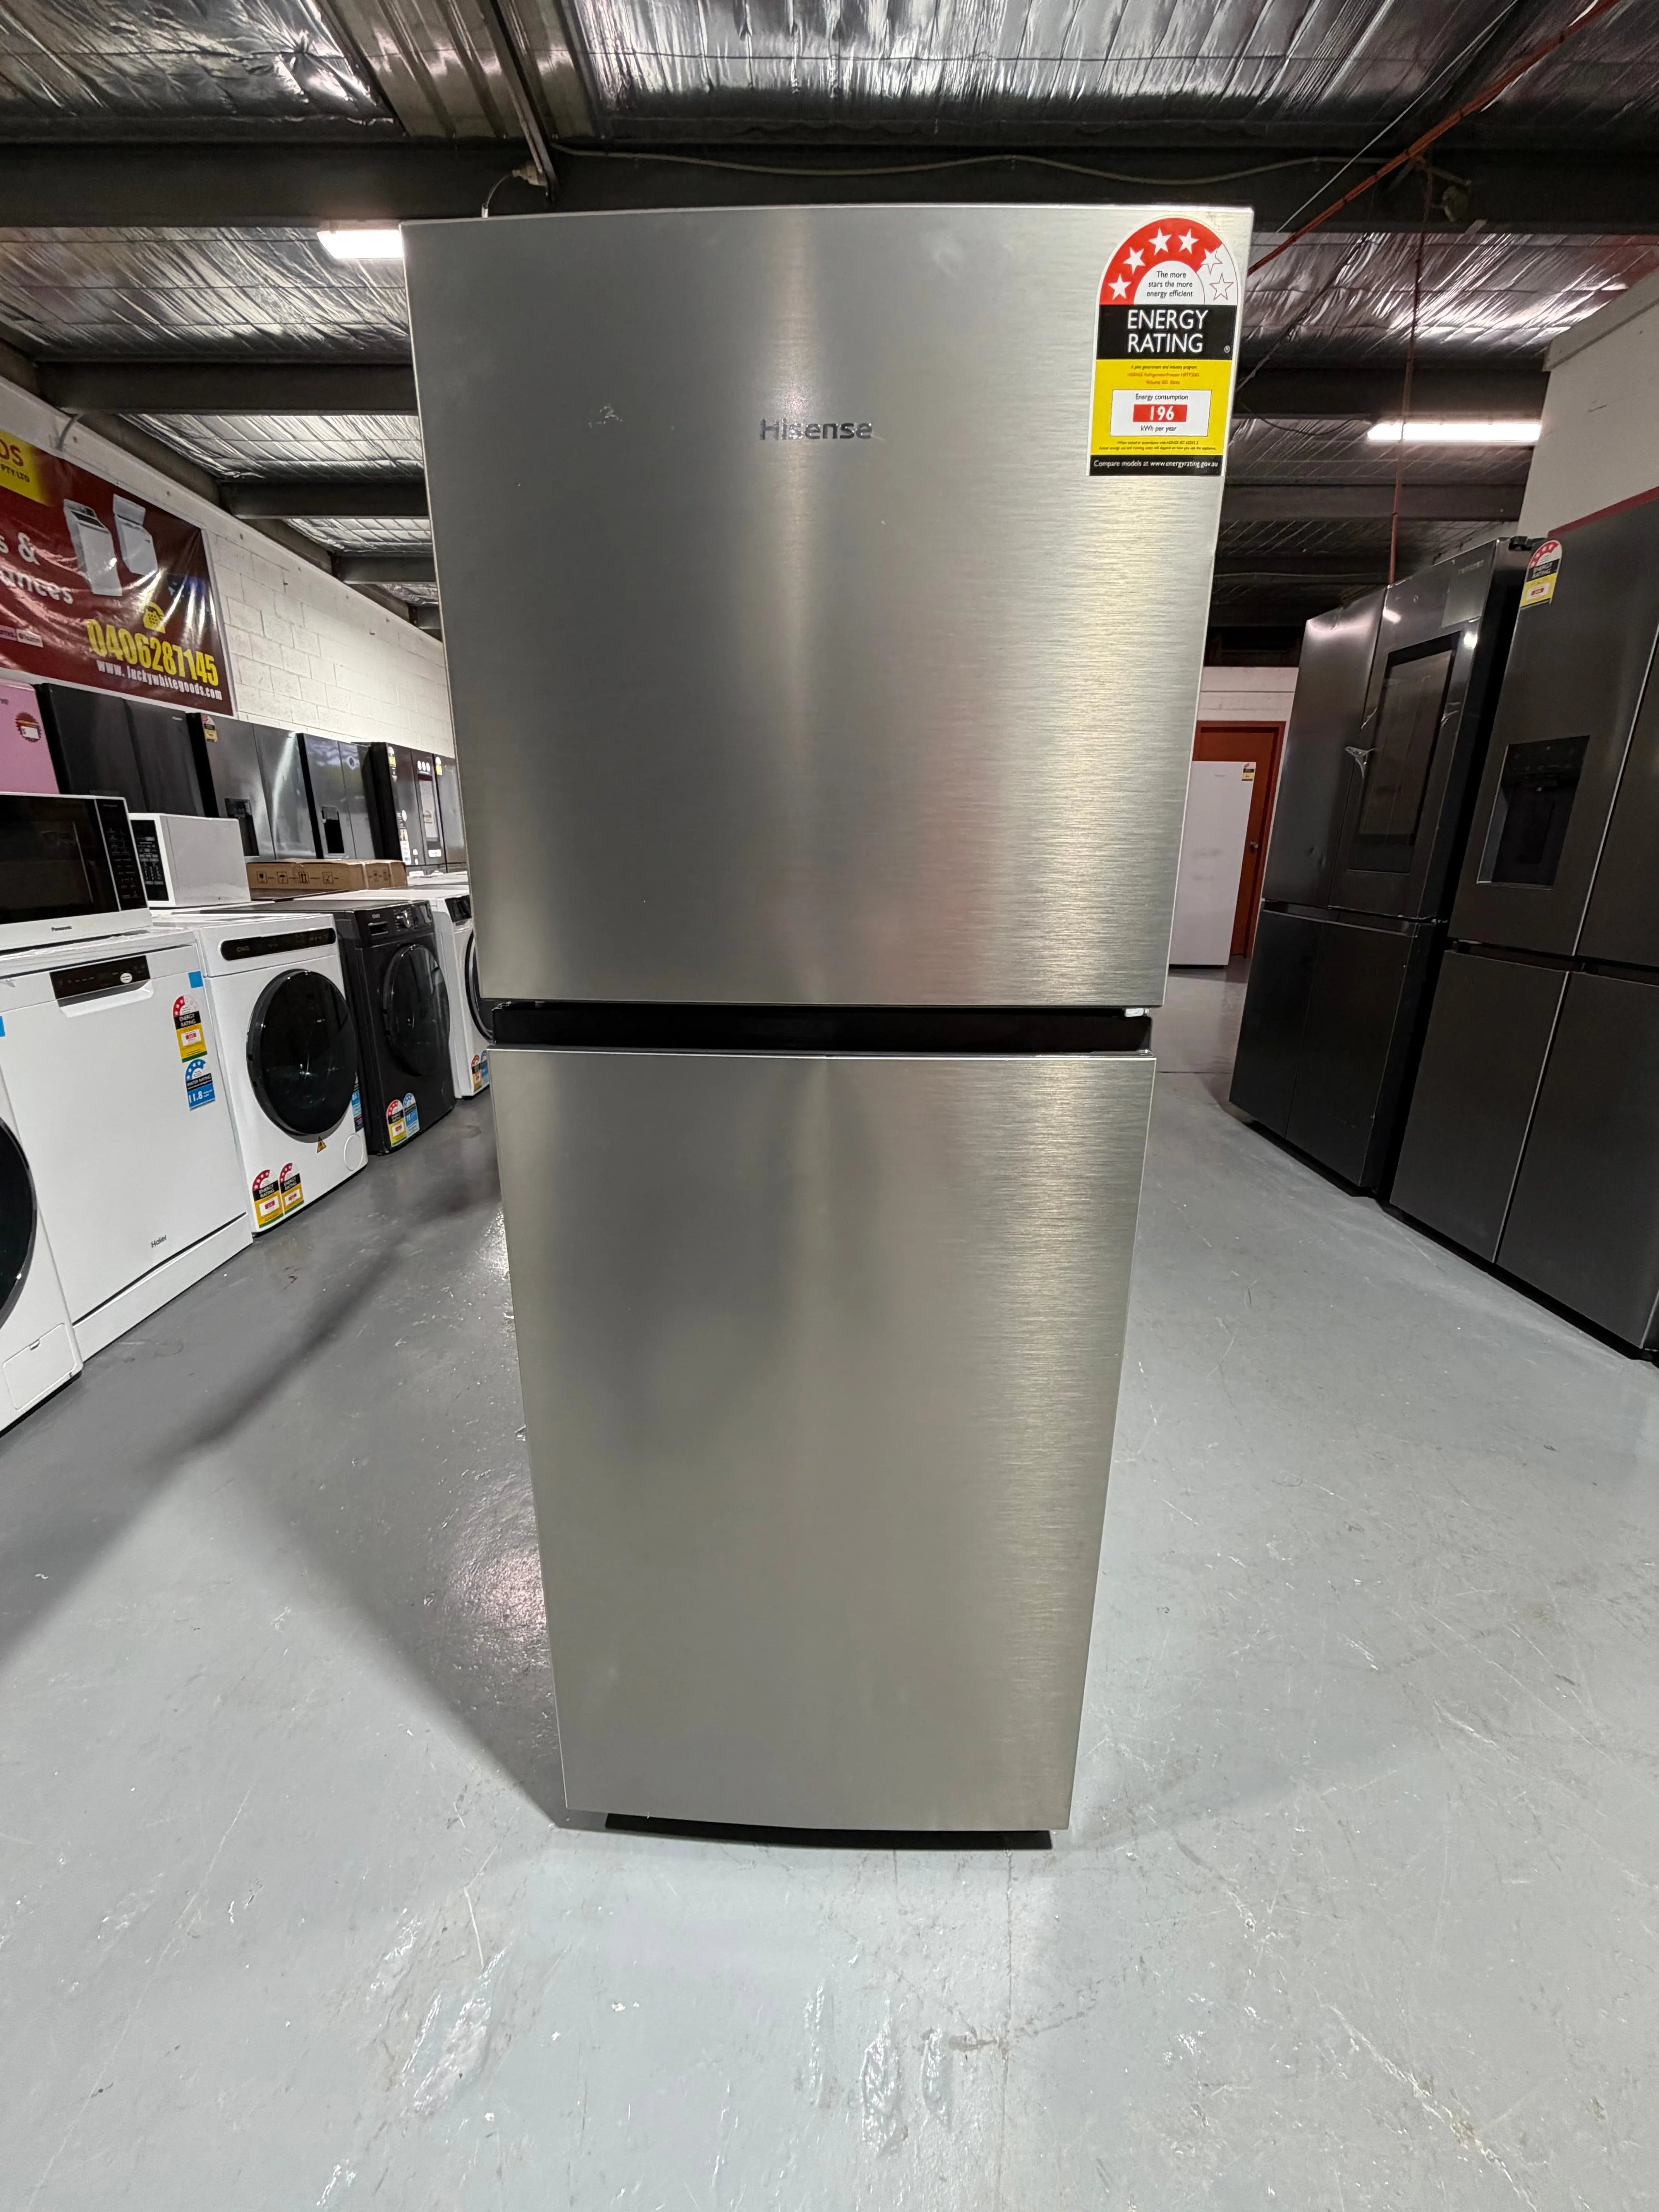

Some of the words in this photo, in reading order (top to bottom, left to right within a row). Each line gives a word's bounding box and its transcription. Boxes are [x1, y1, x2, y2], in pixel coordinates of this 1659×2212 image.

[1127, 309, 1208, 329] ENERGY
[1128, 333, 1203, 353] RATING
[1150, 406, 1175, 421] 196
[759, 417, 872, 440] Hisense
[1094, 460, 1120, 468] Compare
[1150, 460, 1218, 469] www.energyrating.gov.au
[18, 532, 41, 565] &
[86, 619, 219, 686] 0406287145
[189, 1091, 203, 1103] 11.8
[151, 1235, 167, 1248] Haier
